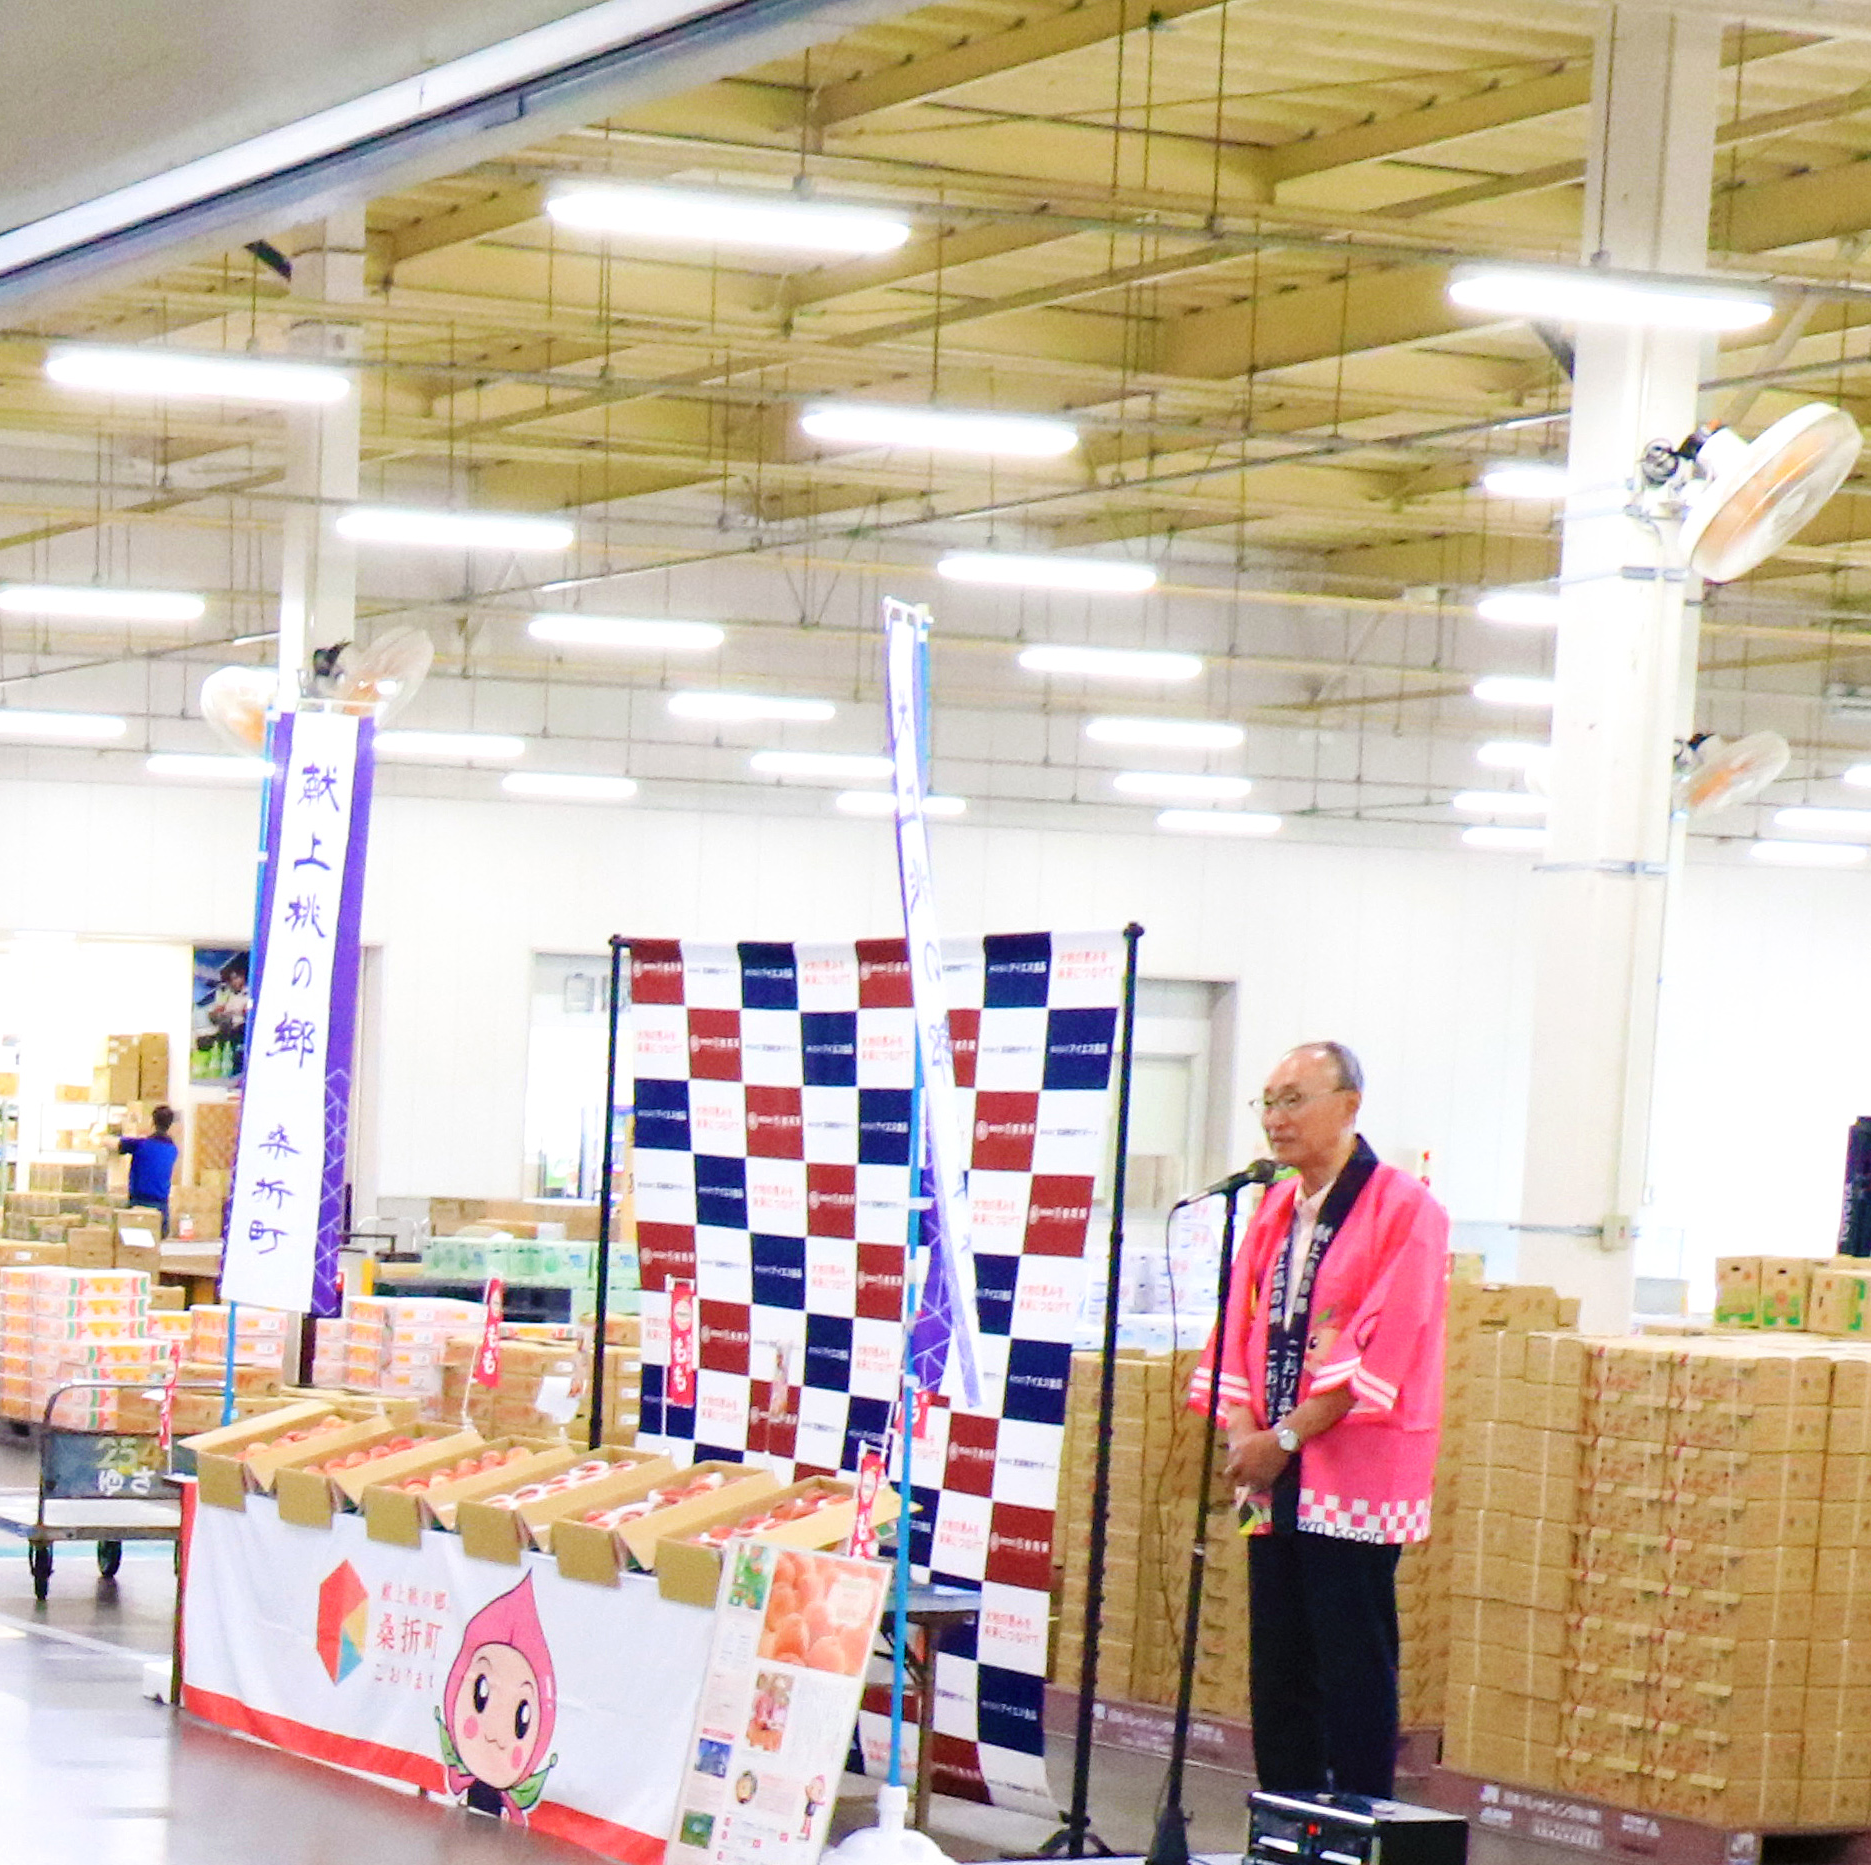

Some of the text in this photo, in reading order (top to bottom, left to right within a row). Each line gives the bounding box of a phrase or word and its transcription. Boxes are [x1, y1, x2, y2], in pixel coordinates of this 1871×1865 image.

[248, 762, 341, 1255] 献上桃の郷 桑折町
[377, 1612, 443, 1660] 桑折町
